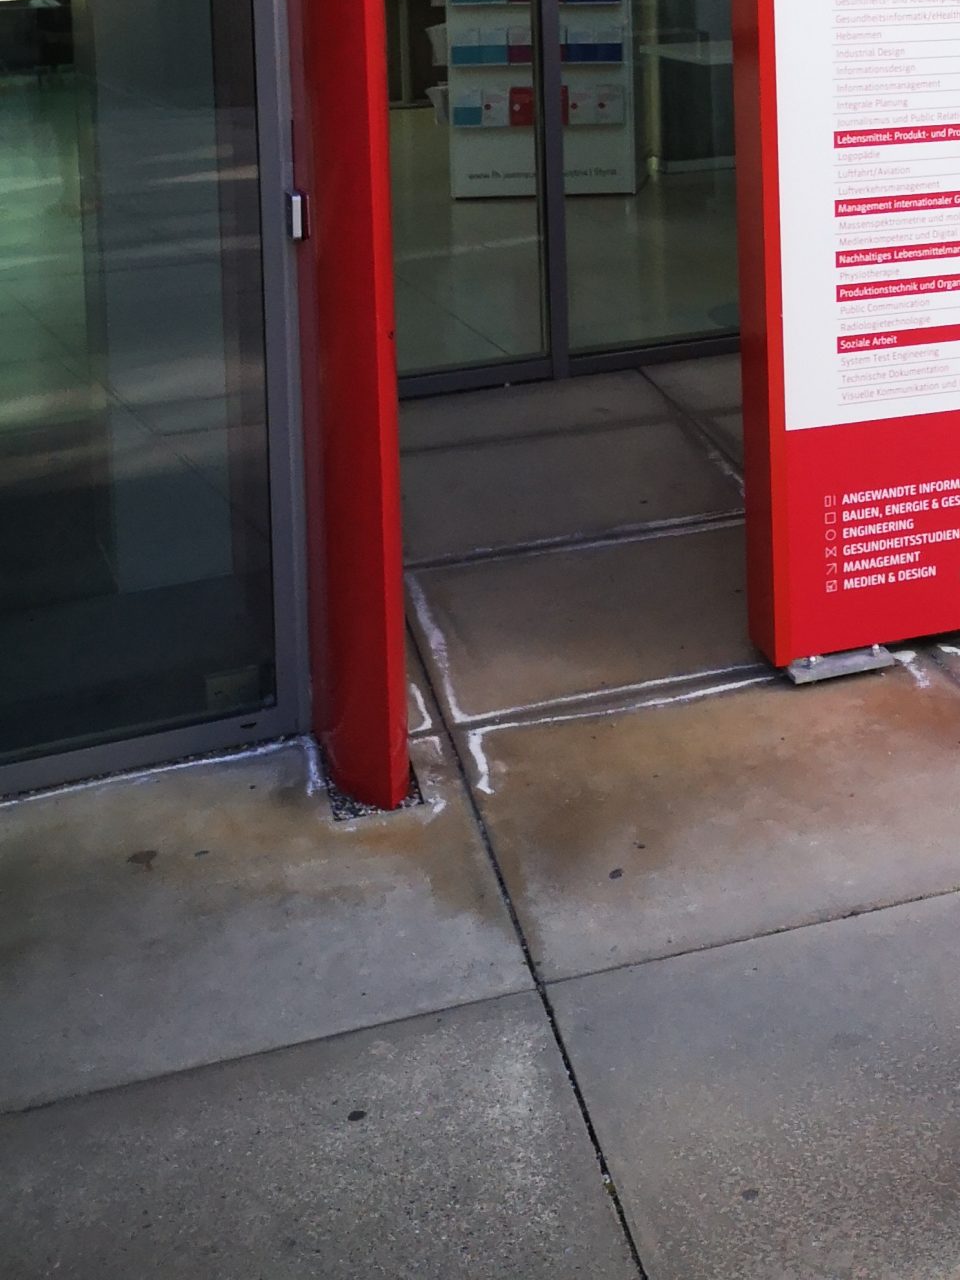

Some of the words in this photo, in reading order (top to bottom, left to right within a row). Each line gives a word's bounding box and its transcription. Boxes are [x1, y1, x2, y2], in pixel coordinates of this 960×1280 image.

[837, 132, 892, 144] Lebensmittel:
[895, 130, 929, 140] Produkt-
[932, 129, 946, 138] und
[838, 201, 891, 213] Management
[894, 196, 952, 208] internationaler
[839, 251, 891, 263] Nachhaltiges
[840, 282, 918, 298] Produktionstechnik
[920, 281, 935, 290] und
[841, 338, 870, 349] Soziale
[872, 336, 897, 346] Arbeit
[842, 485, 916, 505] ANGEWANDTE
[843, 507, 882, 521] BAUEN,
[885, 500, 929, 515] ENERGIE
[932, 498, 939, 509] &
[843, 519, 913, 538] ENGINEERING
[843, 529, 960, 556] GESUNDHEITSSTUDIEN
[844, 551, 920, 572] MANAGEMENT
[844, 574, 885, 589] MEDIEN
[888, 572, 895, 583] &
[898, 566, 936, 581] DESIGN
